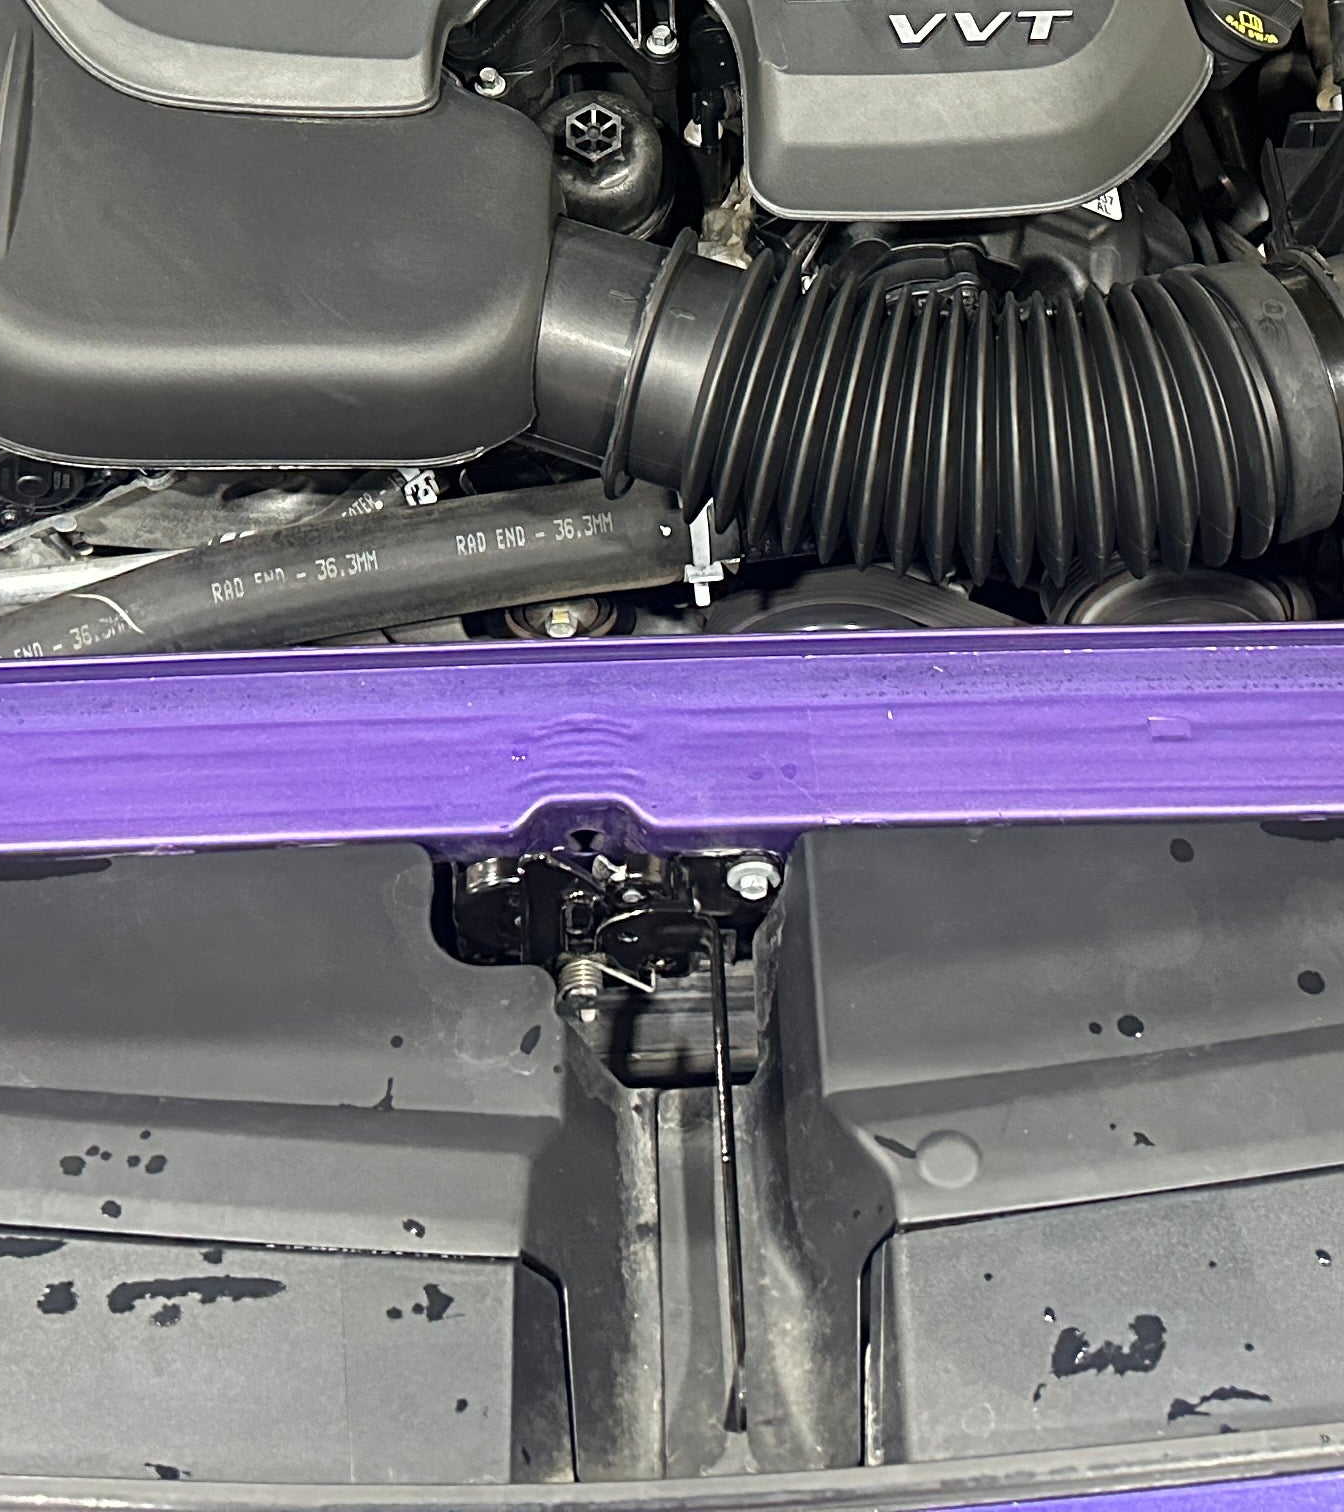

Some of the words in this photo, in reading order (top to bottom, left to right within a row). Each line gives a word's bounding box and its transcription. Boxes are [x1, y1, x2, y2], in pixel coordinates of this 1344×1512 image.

[887, 10, 1074, 47] VVT
[341, 492, 377, 518] ATER
[455, 531, 487, 556] RAD
[495, 525, 526, 550] END
[553, 511, 614, 541] 36.3MM
[211, 577, 245, 604] RAD
[315, 549, 379, 581] 36.3MM
